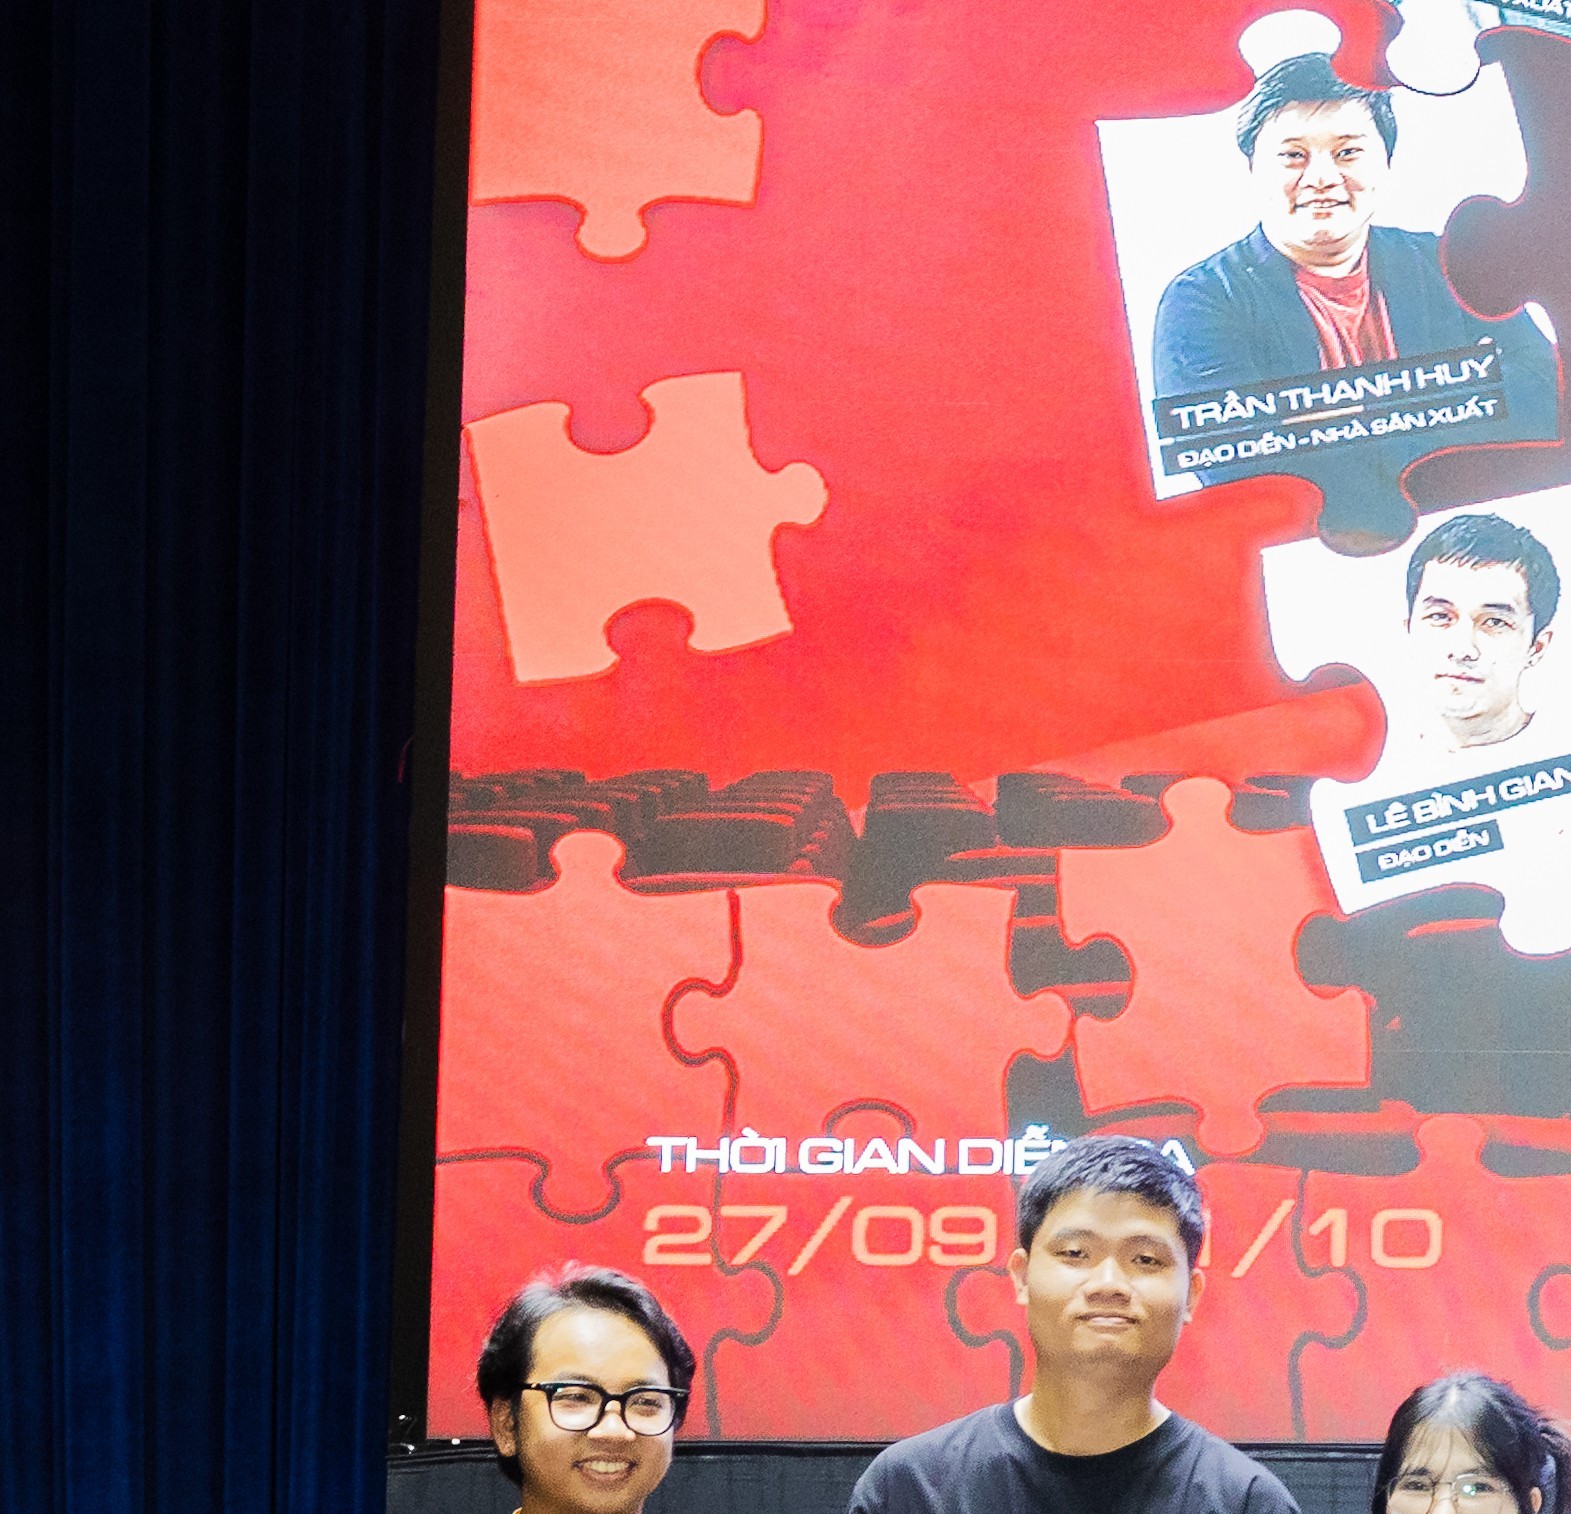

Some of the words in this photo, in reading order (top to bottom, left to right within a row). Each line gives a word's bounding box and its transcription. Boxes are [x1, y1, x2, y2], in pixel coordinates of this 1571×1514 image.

[1171, 390, 1277, 430] TRẦN
[1279, 369, 1411, 411] THANH
[1311, 419, 1369, 445] NHÀ
[1365, 800, 1411, 834] LÊ
[1412, 784, 1498, 823] BÌNH
[646, 1126, 785, 1175] THỜI
[799, 1137, 945, 1175] GIAN
[958, 1125, 1068, 1175] DIỄ
[642, 1196, 996, 1275] 27/09
